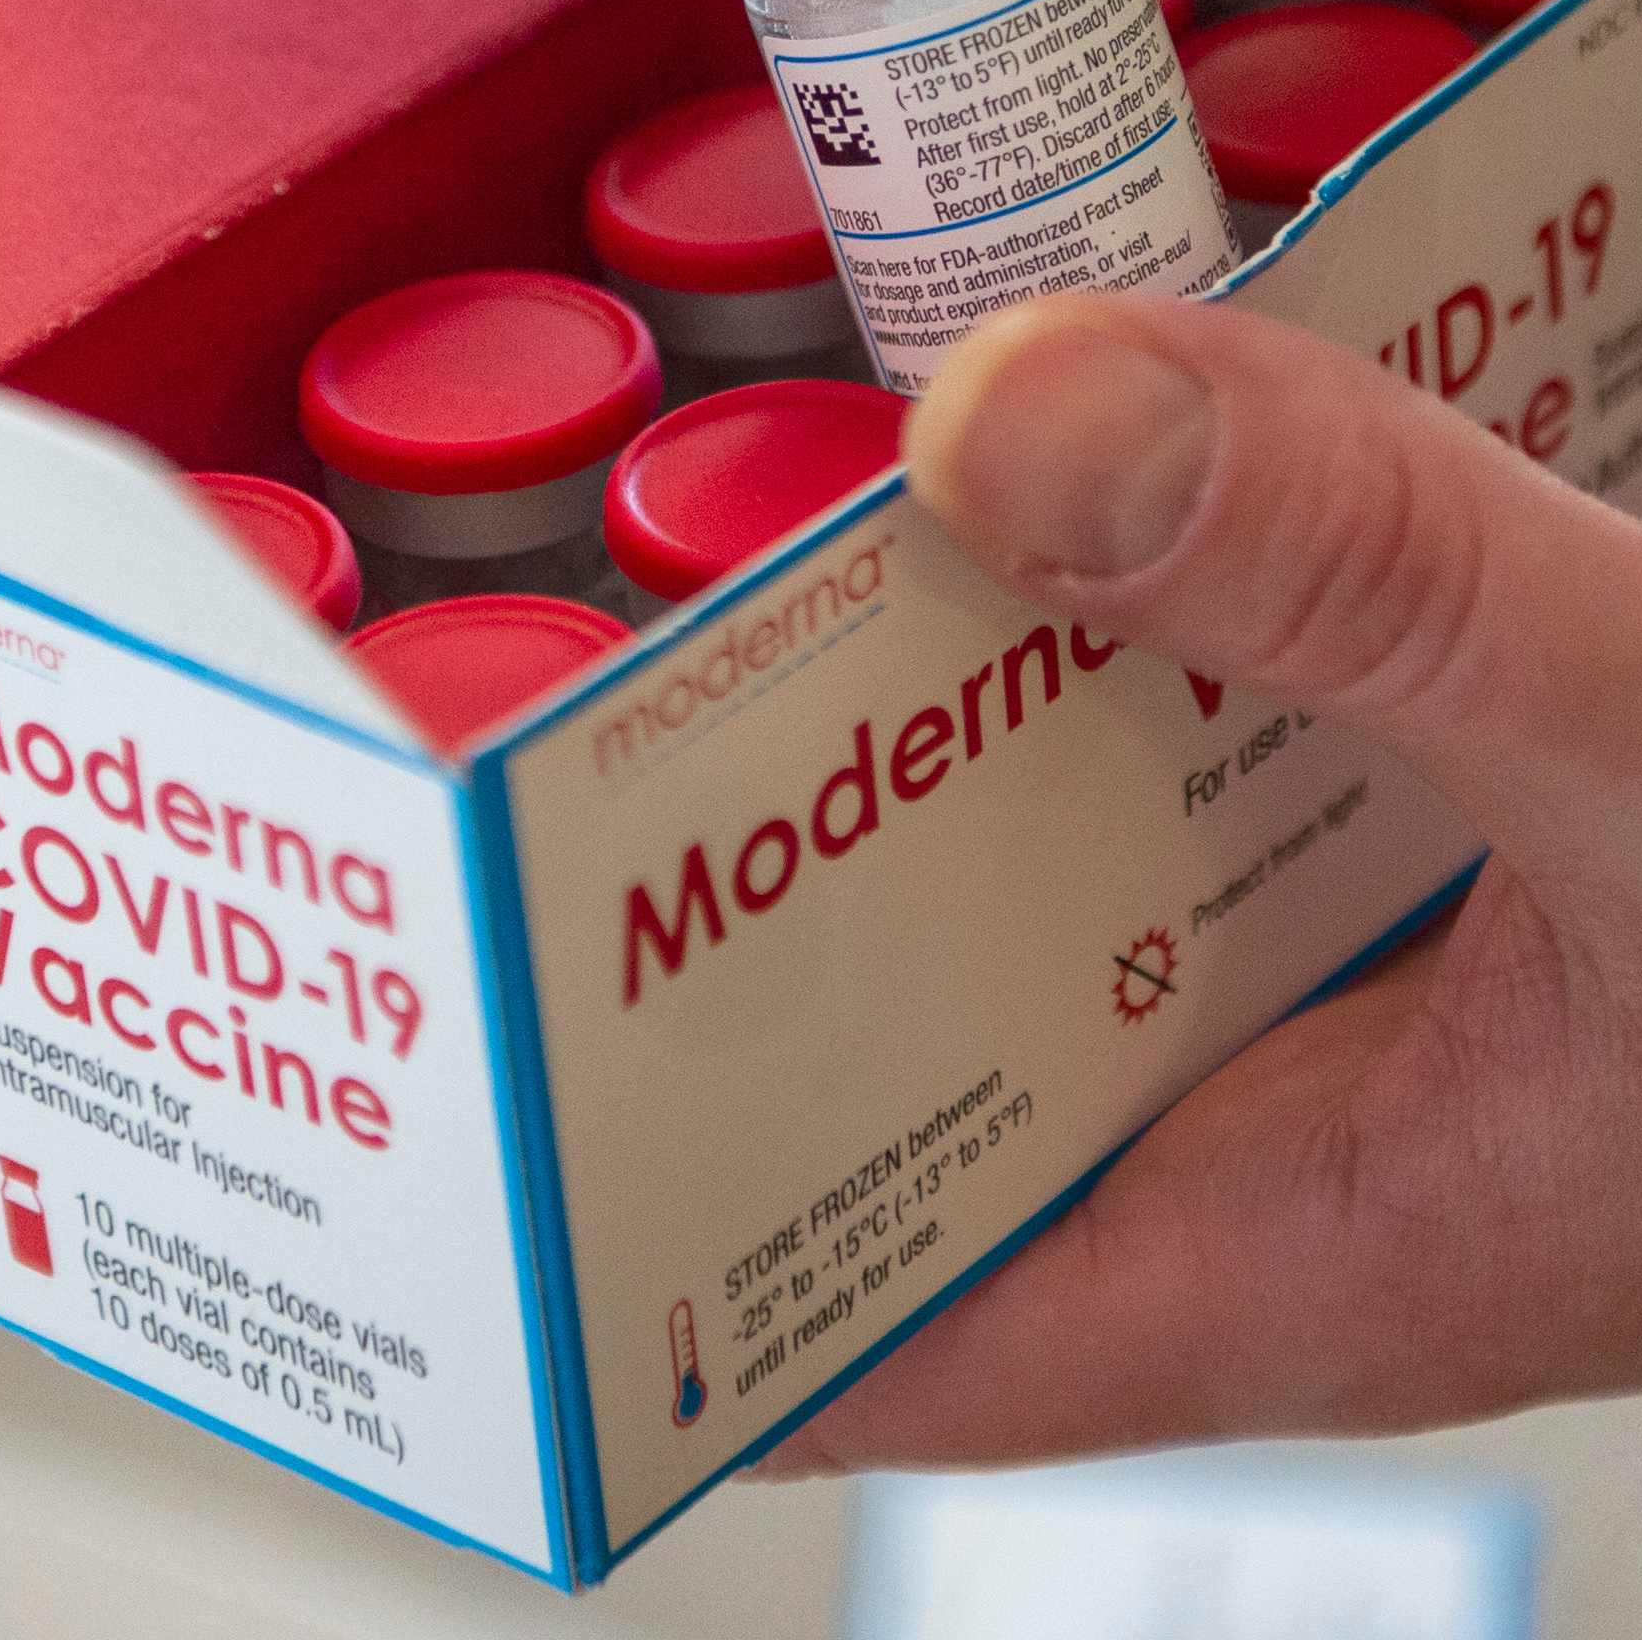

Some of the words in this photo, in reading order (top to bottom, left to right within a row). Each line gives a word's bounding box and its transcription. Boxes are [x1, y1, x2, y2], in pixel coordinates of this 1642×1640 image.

[884, 42, 956, 81] STORE
[959, 8, 1043, 60] FROZEN
[904, 102, 981, 141] Protect
[982, 86, 1033, 118] from
[1035, 60, 1084, 96] light.
[1083, 46, 1107, 73] No
[950, 71, 973, 92] to
[1024, 28, 1066, 65] until
[1065, 5, 1108, 45] ready
[917, 141, 963, 169] After
[967, 123, 1011, 154] first
[1013, 110, 1057, 138] use,
[1057, 83, 1097, 119] hold
[1098, 72, 1117, 98] at
[1042, 107, 1111, 157] Discard
[1113, 86, 1146, 122] after
[1145, 75, 1156, 98] 6
[933, 185, 1007, 223] Record
[1011, 149, 1102, 202] date/time
[1104, 133, 1123, 159] of
[1123, 113, 1154, 149] first
[830, 207, 883, 232] 701861
[846, 255, 878, 277] Scan
[877, 258, 913, 278] here
[913, 256, 937, 276] for
[940, 211, 1082, 271] FDA-authorized
[1083, 192, 1122, 226] Fact
[1121, 165, 1164, 206] Sheet
[865, 304, 886, 322] and
[887, 303, 945, 327] product
[947, 284, 1035, 321] expiration
[1039, 264, 1097, 296] dates,
[1097, 254, 1117, 274] or
[1118, 230, 1154, 262] visit
[873, 282, 924, 304] dosage
[927, 276, 960, 299] and
[963, 237, 1100, 292] administration,
[593, 548, 890, 777] moderna
[1183, 758, 1230, 818] For
[1237, 713, 1289, 776] use
[151, 1082, 193, 1129] for
[191, 1142, 323, 1227] Injection
[724, 1217, 805, 1301] STORE
[810, 1141, 903, 1237] FROZEN
[907, 1069, 1003, 1160] between
[791, 1267, 814, 1301] to
[958, 1137, 981, 1168] to
[74, 1192, 115, 1238] 10
[125, 1216, 342, 1341] multiple-dose
[351, 1315, 429, 1379] vials
[82, 1238, 165, 1300] (each
[175, 1282, 230, 1335] vial
[240, 1315, 377, 1402] contains
[735, 1334, 787, 1398] until
[793, 1285, 855, 1351] ready
[862, 1255, 893, 1297] for
[899, 1220, 945, 1268] use.
[89, 1286, 130, 1333] 10
[140, 1309, 232, 1381] doses
[241, 1361, 273, 1398] of
[282, 1372, 334, 1427] 0.5
[344, 1402, 406, 1465] mL)
